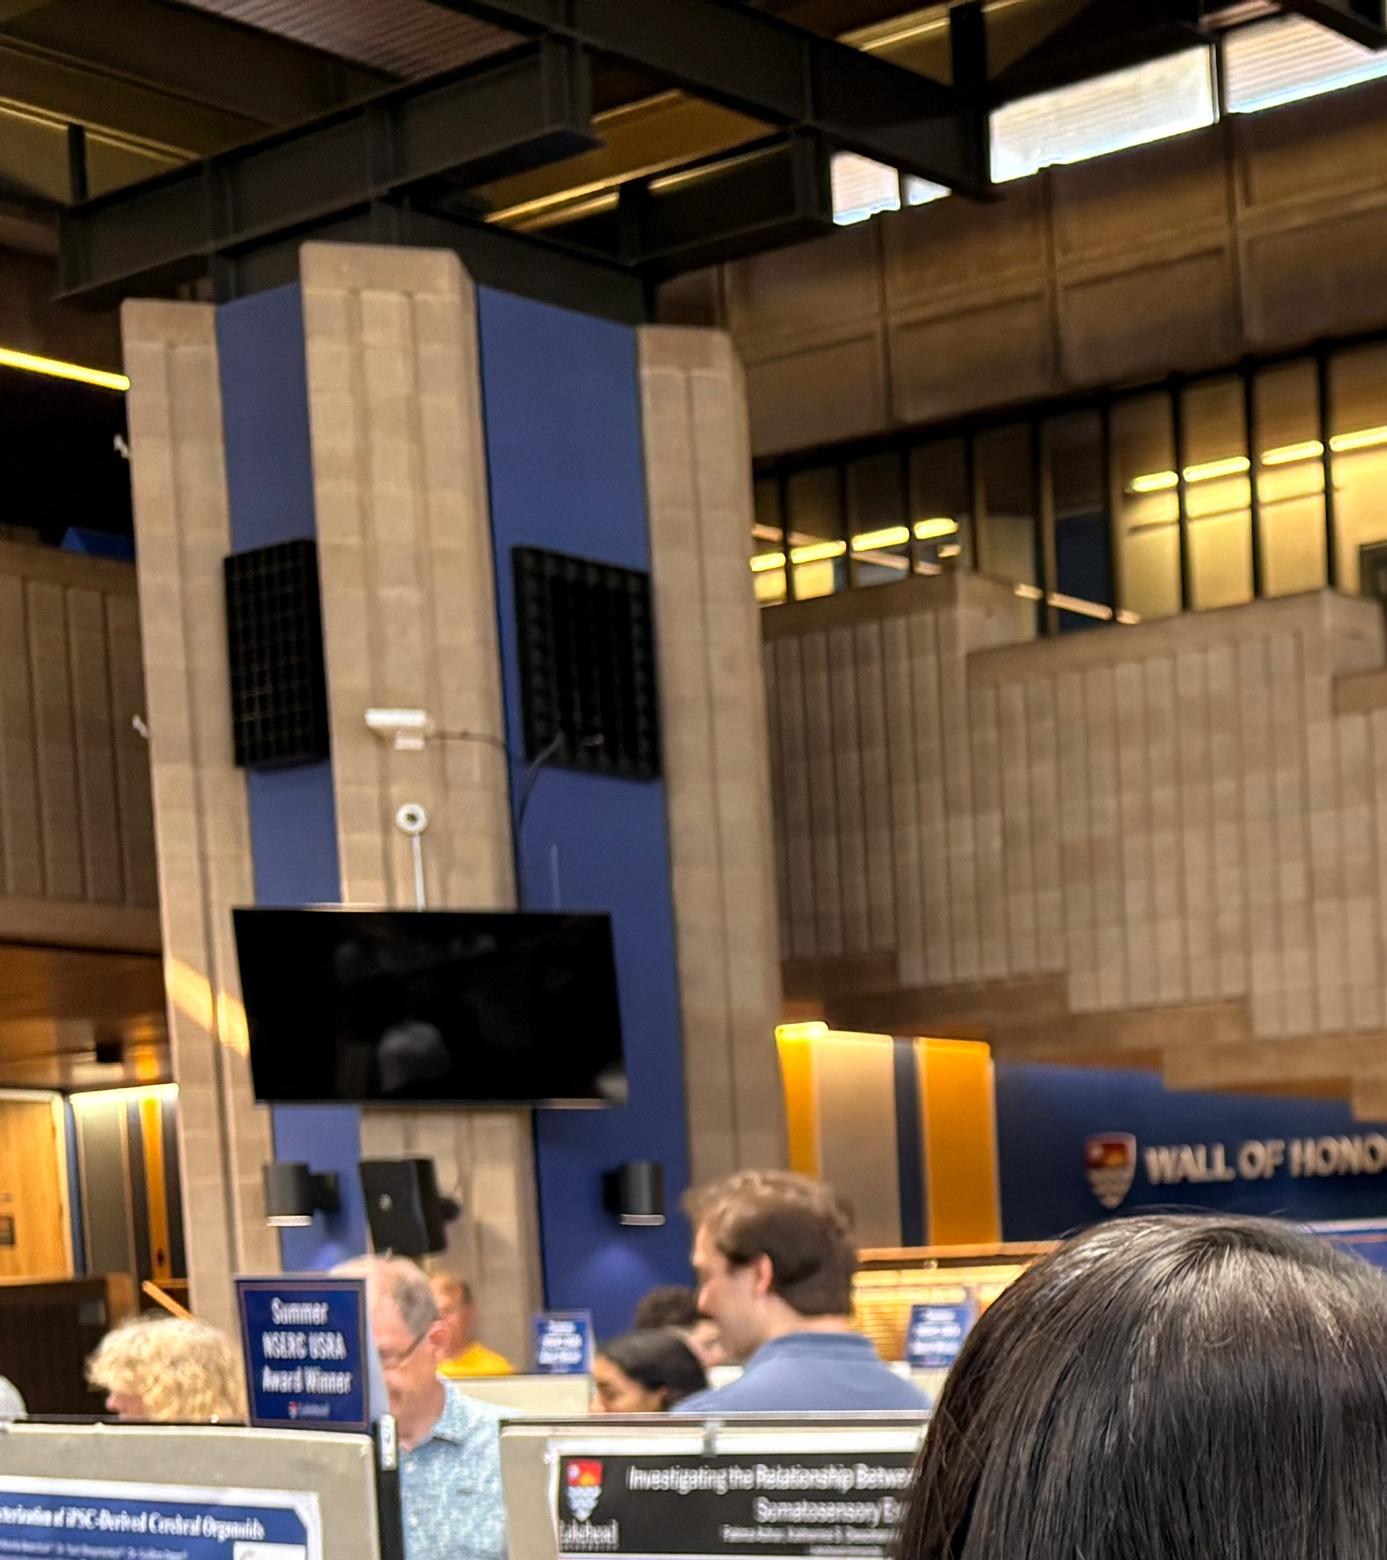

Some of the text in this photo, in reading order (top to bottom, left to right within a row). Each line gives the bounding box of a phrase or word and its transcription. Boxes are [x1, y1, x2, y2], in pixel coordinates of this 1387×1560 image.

[1144, 1142, 1236, 1185] WALL
[1237, 1139, 1285, 1180] OF
[271, 1297, 330, 1326] Summer
[262, 1331, 348, 1361] NSERC USRA
[262, 1366, 354, 1395] Award Winner
[627, 1465, 728, 1495] Investigating
[729, 1465, 754, 1491] the
[754, 1463, 855, 1495] Relationship
